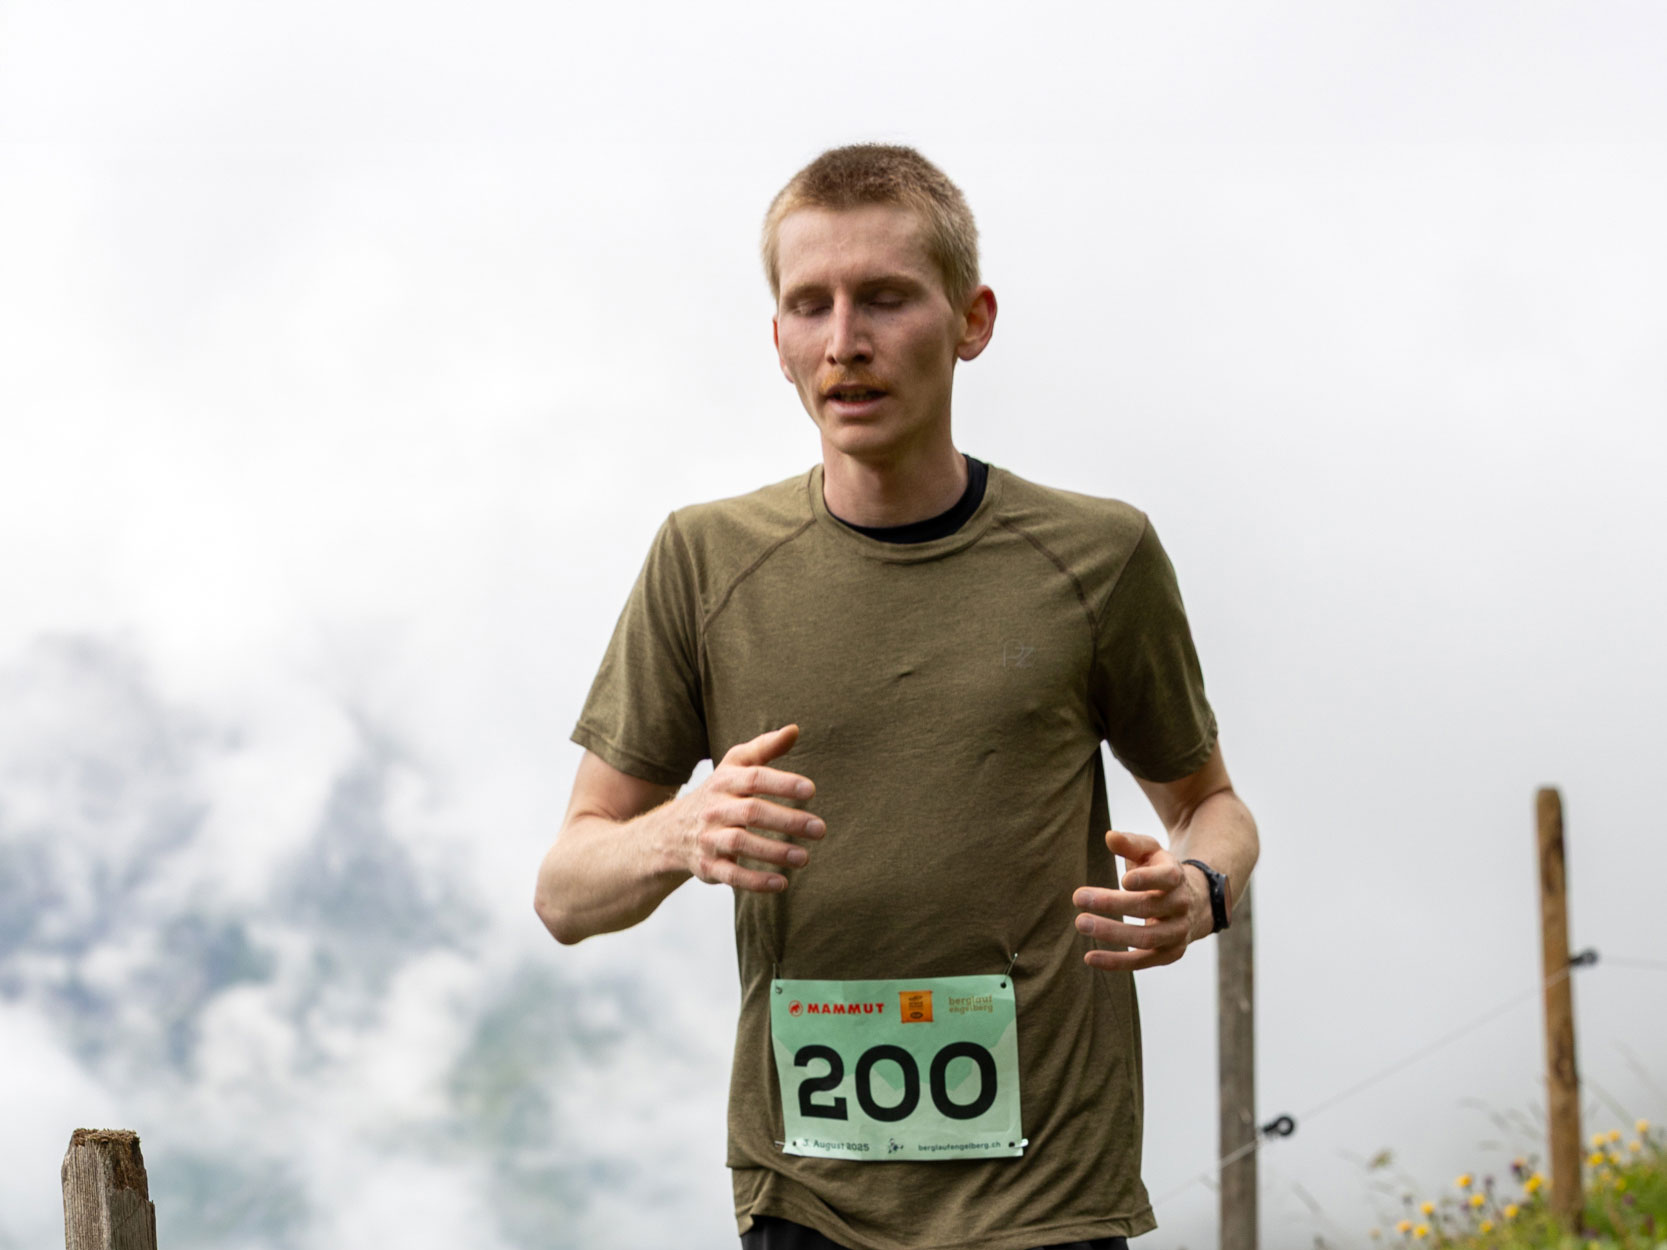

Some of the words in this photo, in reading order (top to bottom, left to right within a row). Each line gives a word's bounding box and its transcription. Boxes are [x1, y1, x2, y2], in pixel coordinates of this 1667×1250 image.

[807, 1002, 884, 1014] MAMMUT
[794, 1041, 998, 1122] 200
[813, 1139, 845, 1151] August
[846, 1142, 870, 1152] 2025
[918, 1142, 1001, 1152] berglaufengelberg.ch
